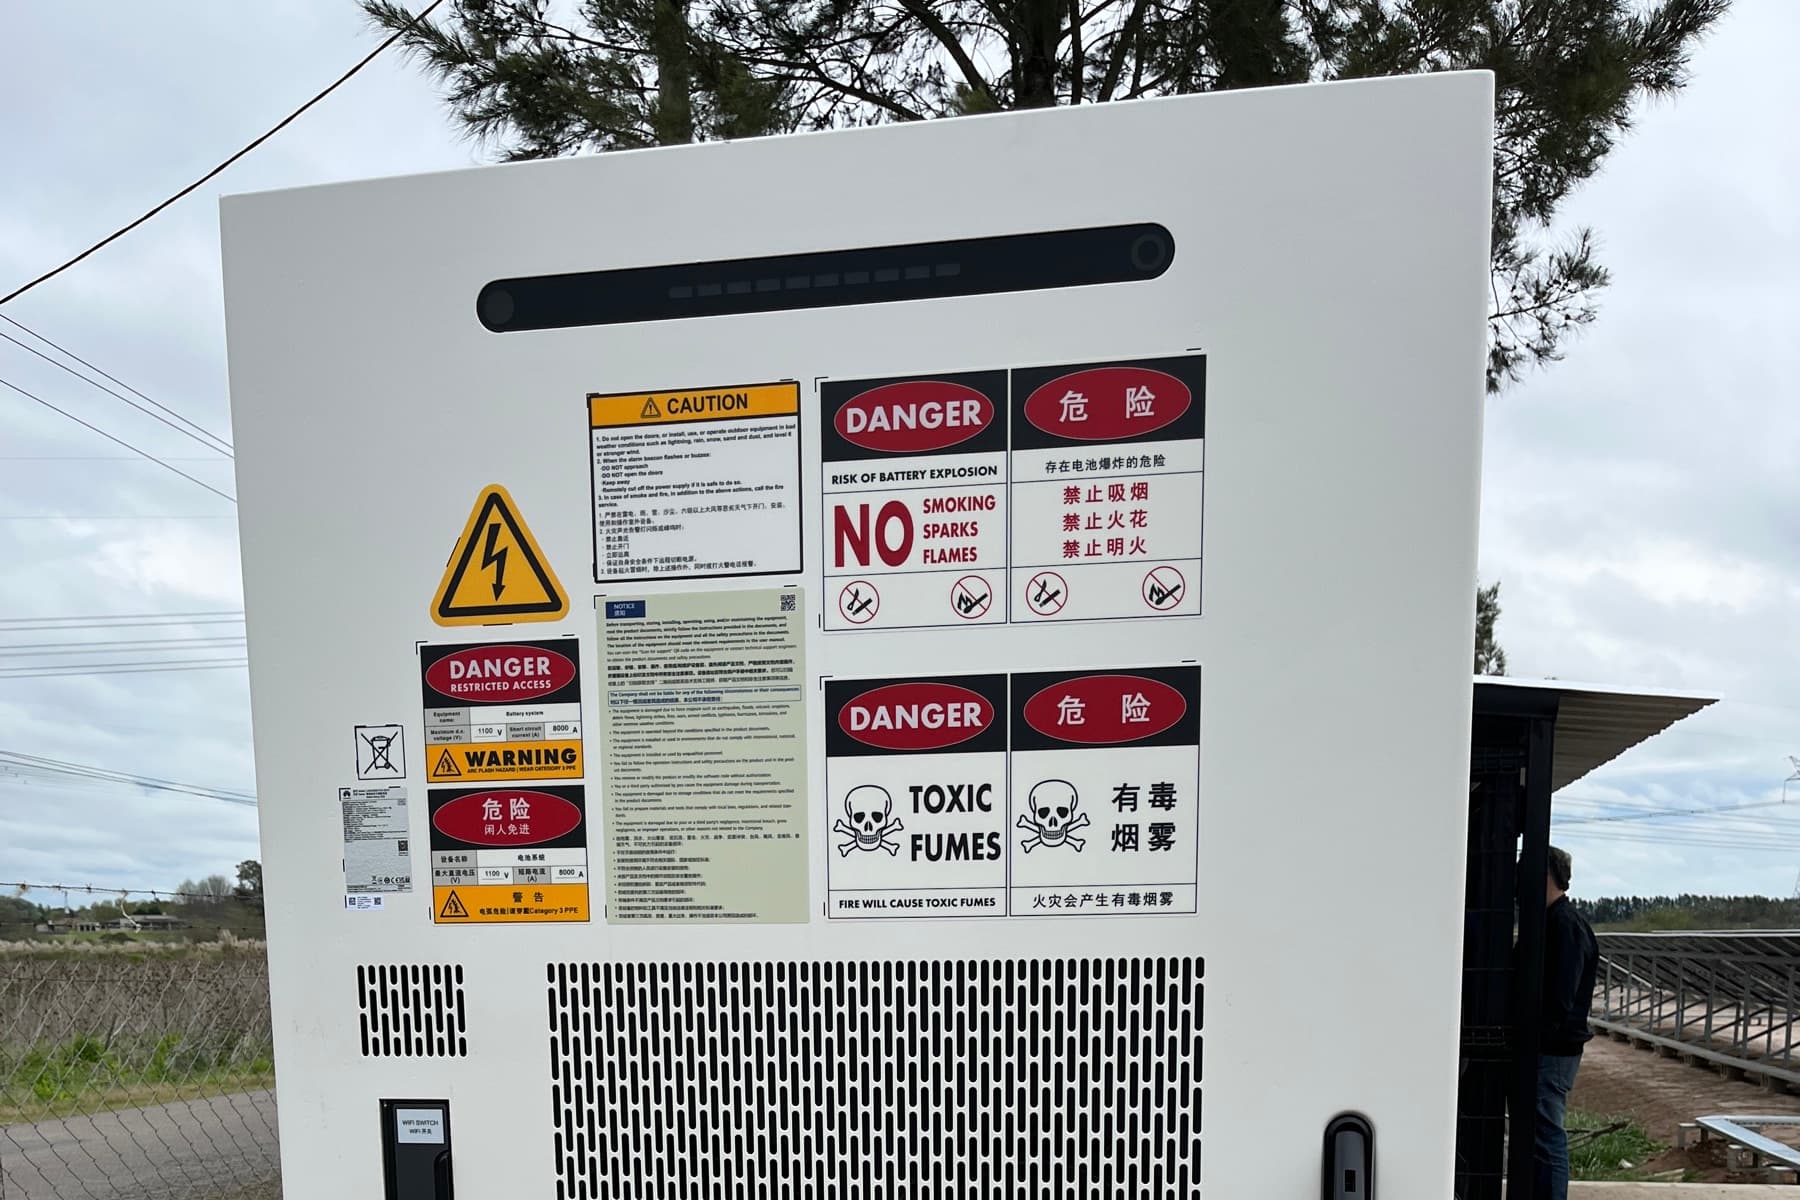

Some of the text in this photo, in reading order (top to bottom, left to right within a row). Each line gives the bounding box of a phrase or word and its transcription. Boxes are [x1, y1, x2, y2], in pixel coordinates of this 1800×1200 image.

[667, 393, 748, 414] CAUTION
[1059, 385, 1156, 422] 危险
[846, 400, 983, 433] DANGER
[1045, 454, 1166, 474] 存在电池爆炸的危险
[831, 465, 998, 485] RISK OF BATTERY EXPLOSION
[1063, 482, 1149, 505] 禁止吸烟
[923, 494, 996, 514] SMOKING
[923, 521, 979, 539] SPARKS
[1063, 509, 1149, 533] 禁止火花
[834, 500, 914, 567] NO
[923, 547, 978, 564] FLAMES
[1063, 536, 1147, 559] 禁止明火
[450, 657, 551, 680] DANGER
[450, 680, 552, 693] RESTRICTED ACCESS
[850, 702, 983, 732] DANGER
[1057, 692, 1151, 726] 危险
[478, 727, 503, 737] 1100 V
[572, 726, 579, 734] A
[465, 748, 577, 768] WARNING
[909, 783, 992, 814] TOXIC
[1111, 781, 1177, 813] 有毒
[482, 797, 531, 821] 危险
[484, 824, 531, 836] 闲人免进
[1111, 823, 1177, 852] 烟雾
[910, 832, 1001, 862] FUMES
[440, 855, 468, 864] 设备名称
[517, 854, 546, 862] 电池系统
[512, 891, 544, 903] 警告
[838, 897, 996, 909] FIRE WILL CAUSE TOXIC FUMES
[1032, 892, 1174, 909] 火灾会产生有毒烟雾
[564, 906, 579, 914] PPE
